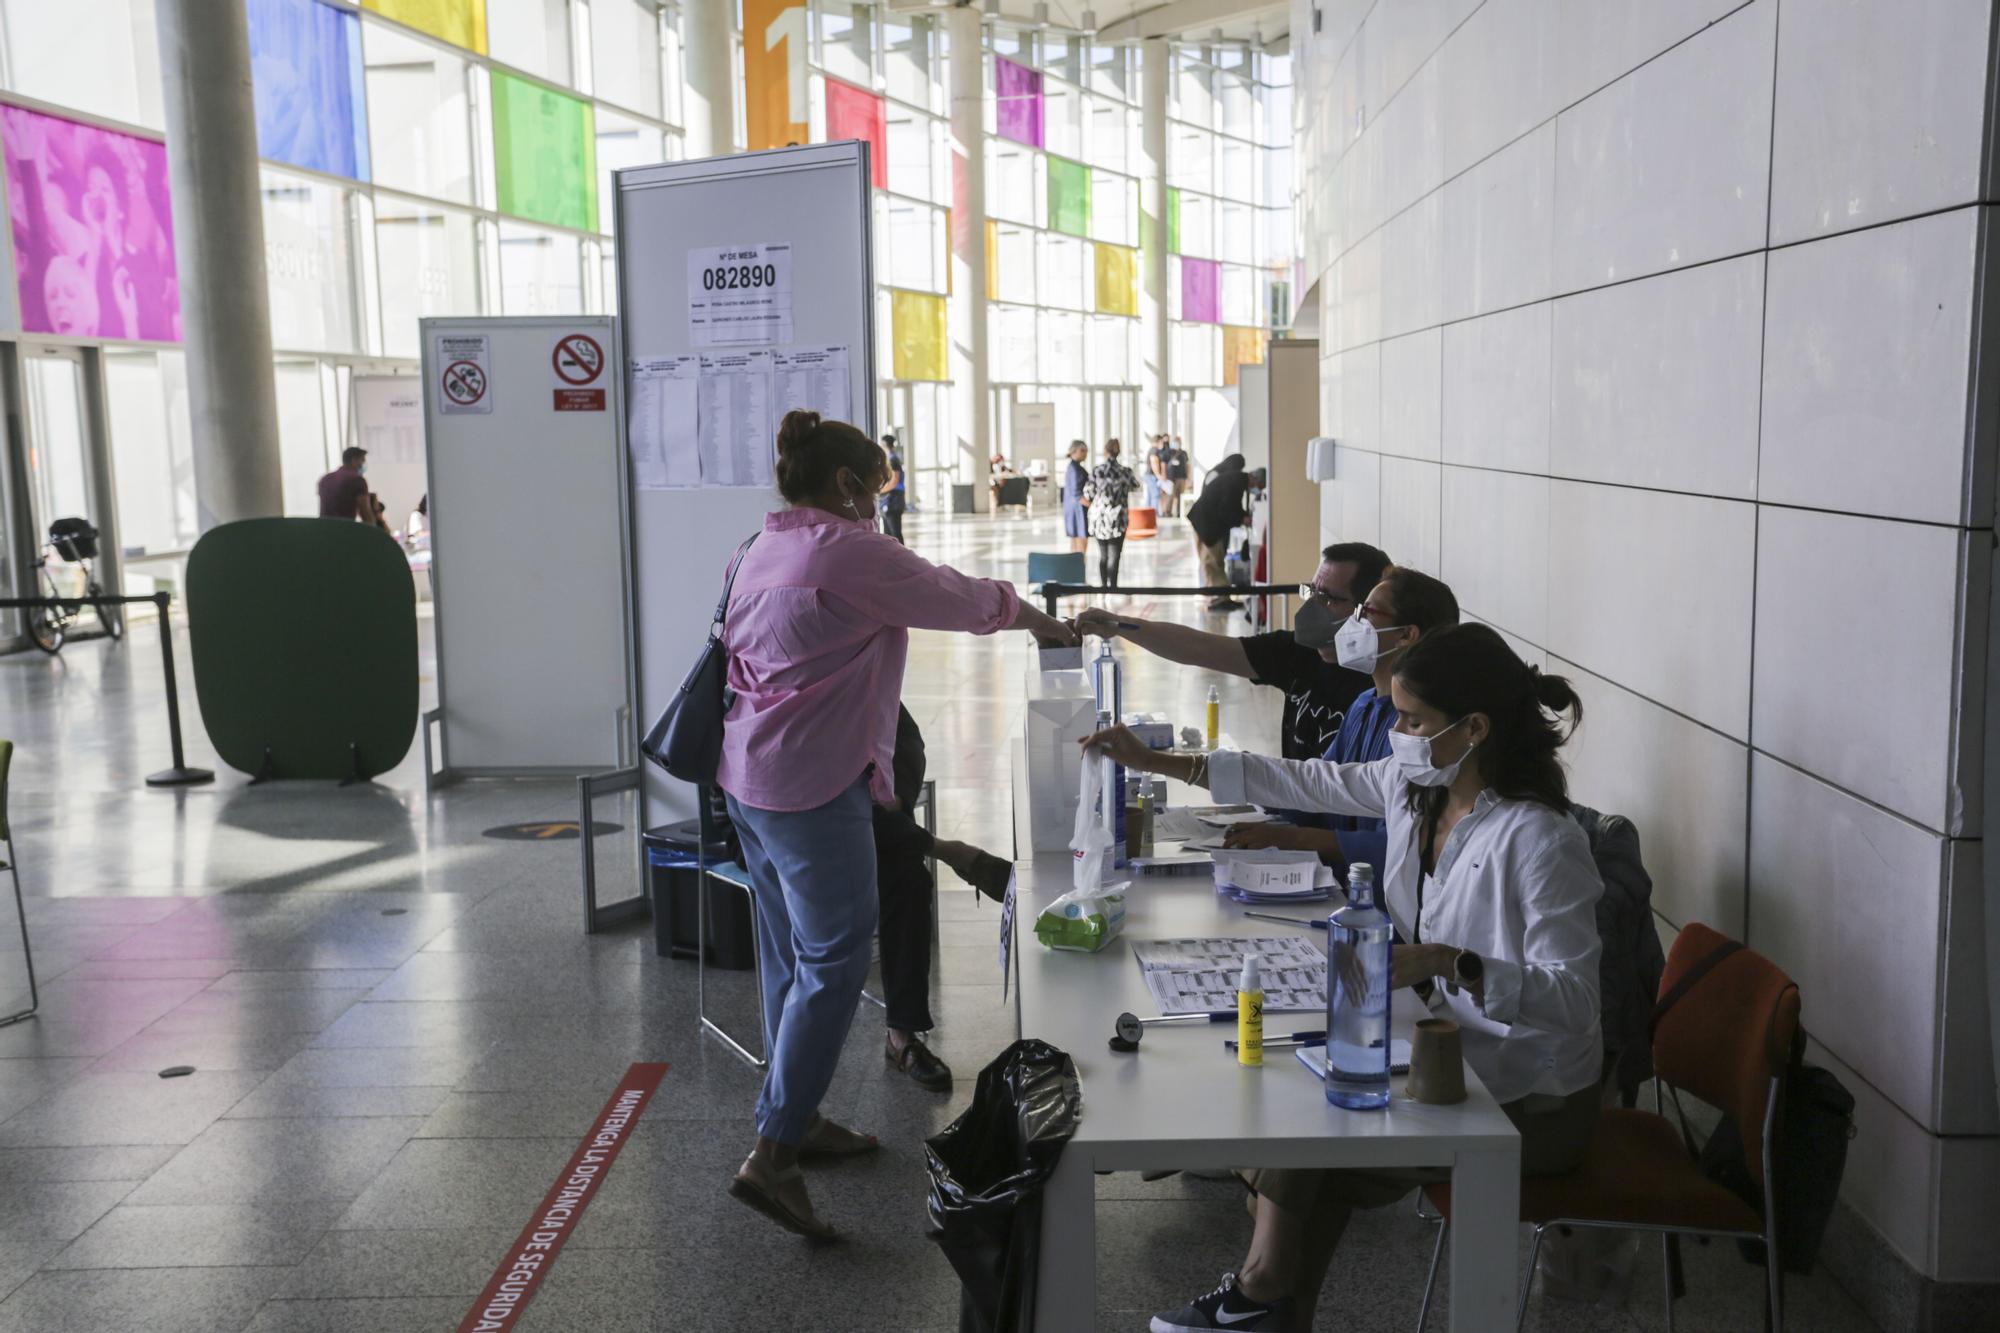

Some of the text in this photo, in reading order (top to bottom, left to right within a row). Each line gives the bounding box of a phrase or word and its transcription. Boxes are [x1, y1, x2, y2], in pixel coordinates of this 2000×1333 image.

[728, 252, 737, 260] DE
[739, 251, 758, 260] MESA
[703, 264, 775, 290] 082890
[470, 1090, 644, 1333] MANTENGA LA DISTANCIA DE SEGURIDA
